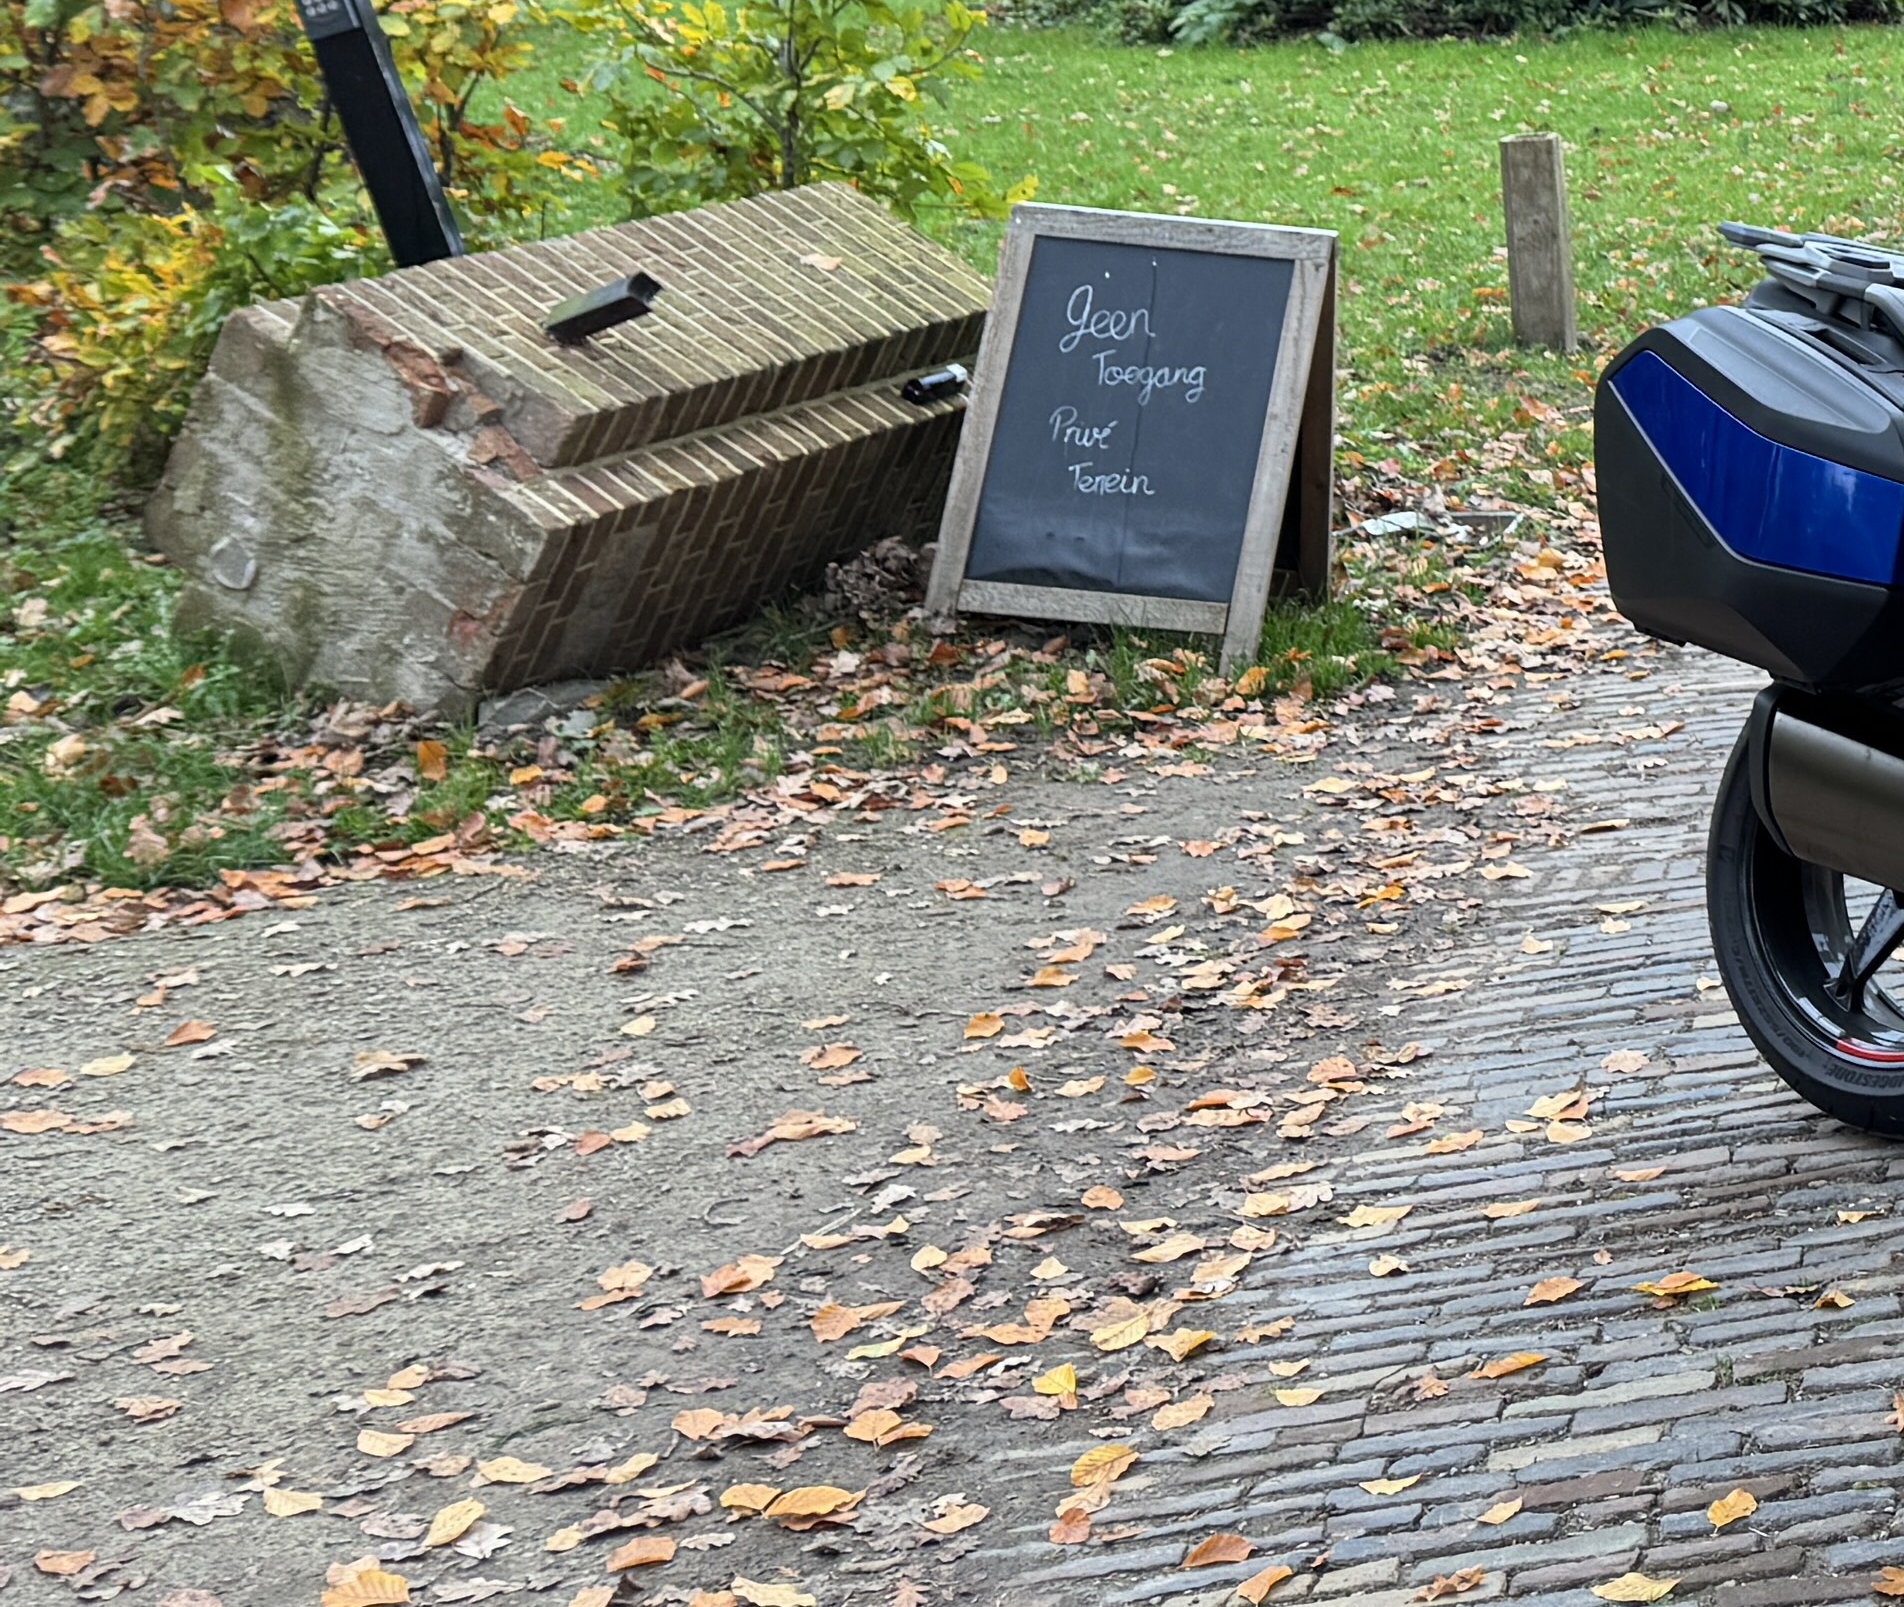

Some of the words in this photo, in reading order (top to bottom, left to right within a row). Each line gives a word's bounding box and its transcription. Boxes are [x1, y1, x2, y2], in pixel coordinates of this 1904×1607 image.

[1092, 349, 1207, 406] Toegang
[1049, 405, 1119, 450] Privé
[1068, 461, 1156, 496] Terrein
